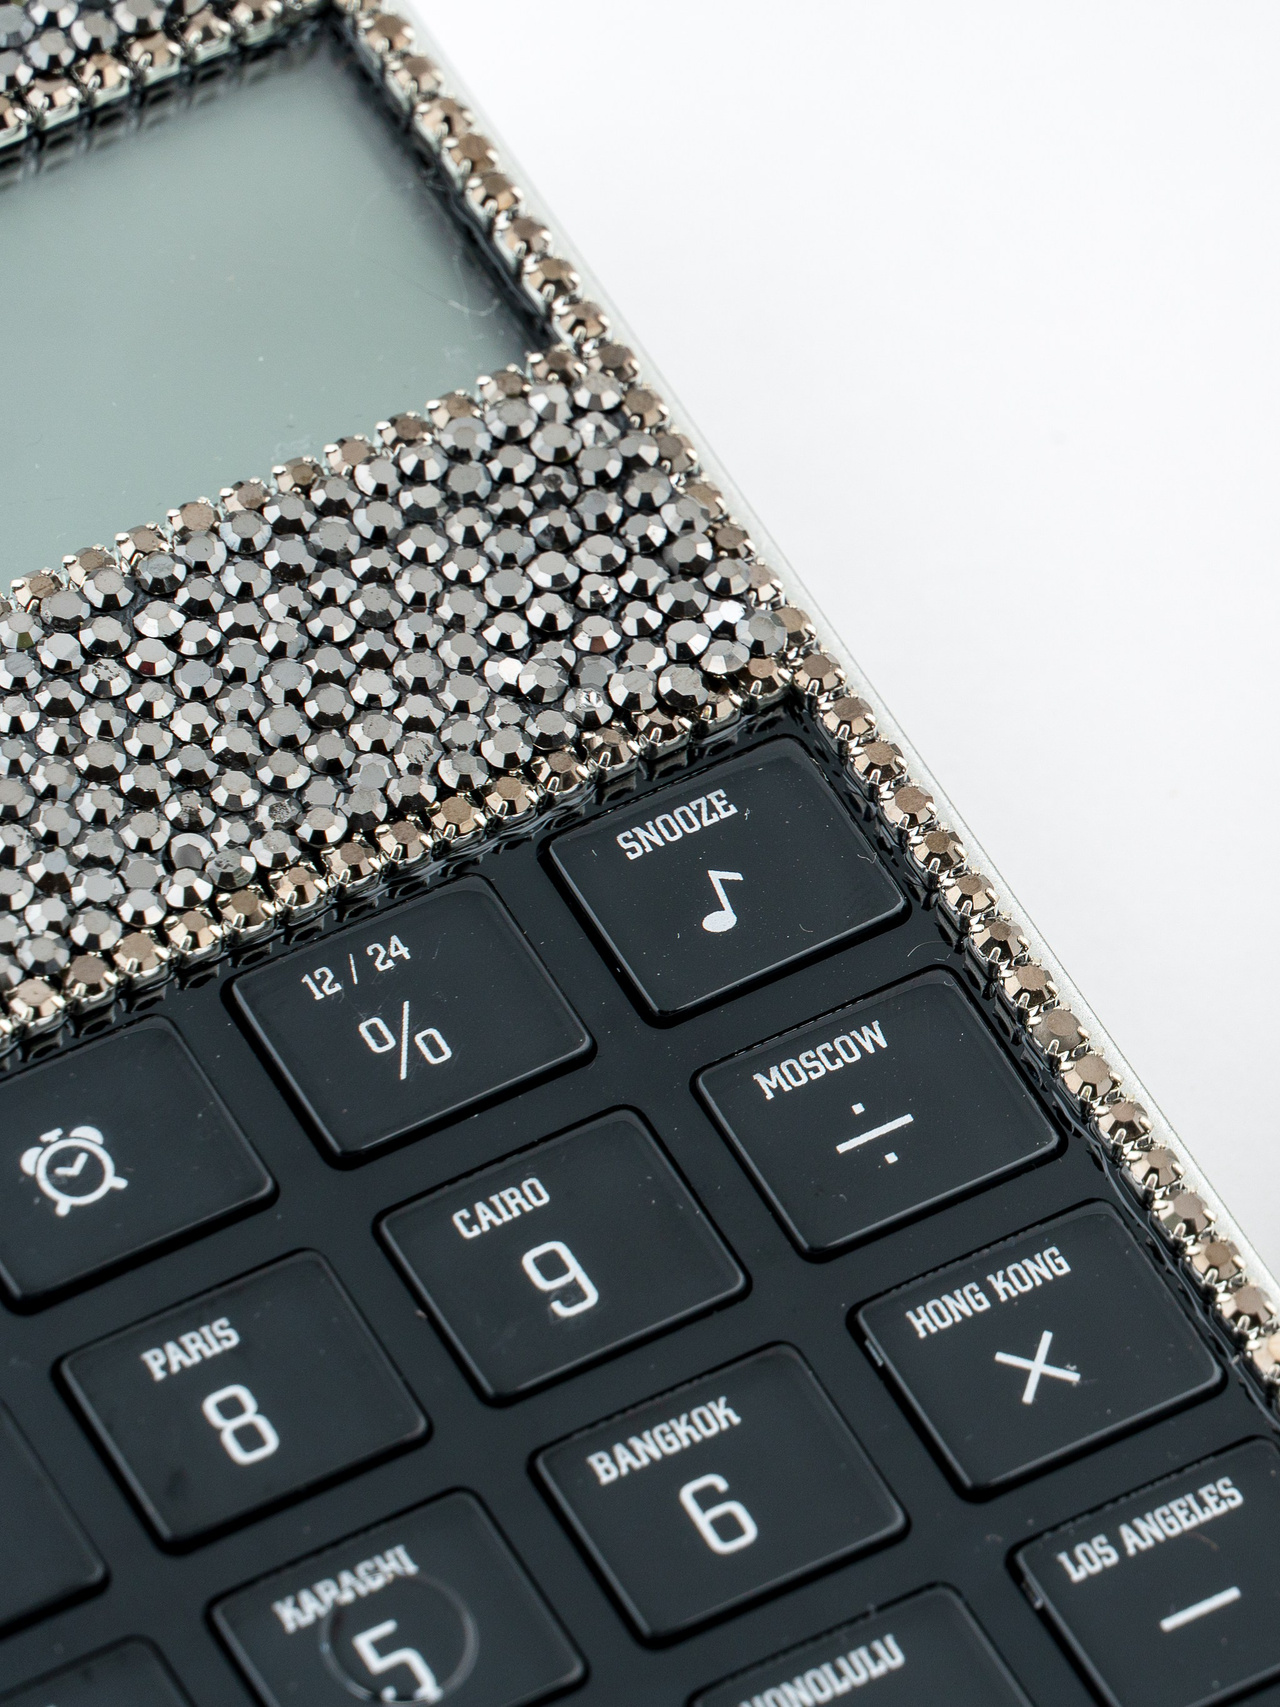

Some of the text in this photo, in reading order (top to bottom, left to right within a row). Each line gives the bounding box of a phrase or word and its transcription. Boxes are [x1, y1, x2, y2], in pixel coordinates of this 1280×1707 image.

[616, 788, 739, 861] SNOOZE
[358, 1000, 453, 1081] %
[752, 1019, 888, 1101] MOSCOW
[452, 1177, 551, 1240] CAIRO
[521, 1240, 599, 1318] 9
[905, 1246, 1072, 1339] HONG KONG
[141, 1317, 240, 1382] PARIS
[202, 1384, 280, 1465] 8
[587, 1396, 742, 1489] BANGKOK
[679, 1473, 758, 1555] 6
[1057, 1476, 1244, 1583] LOS ANGELES
[273, 1545, 419, 1637] KARACHI
[353, 1619, 443, 1703] 5
[740, 1633, 905, 1707] ONOLULU
